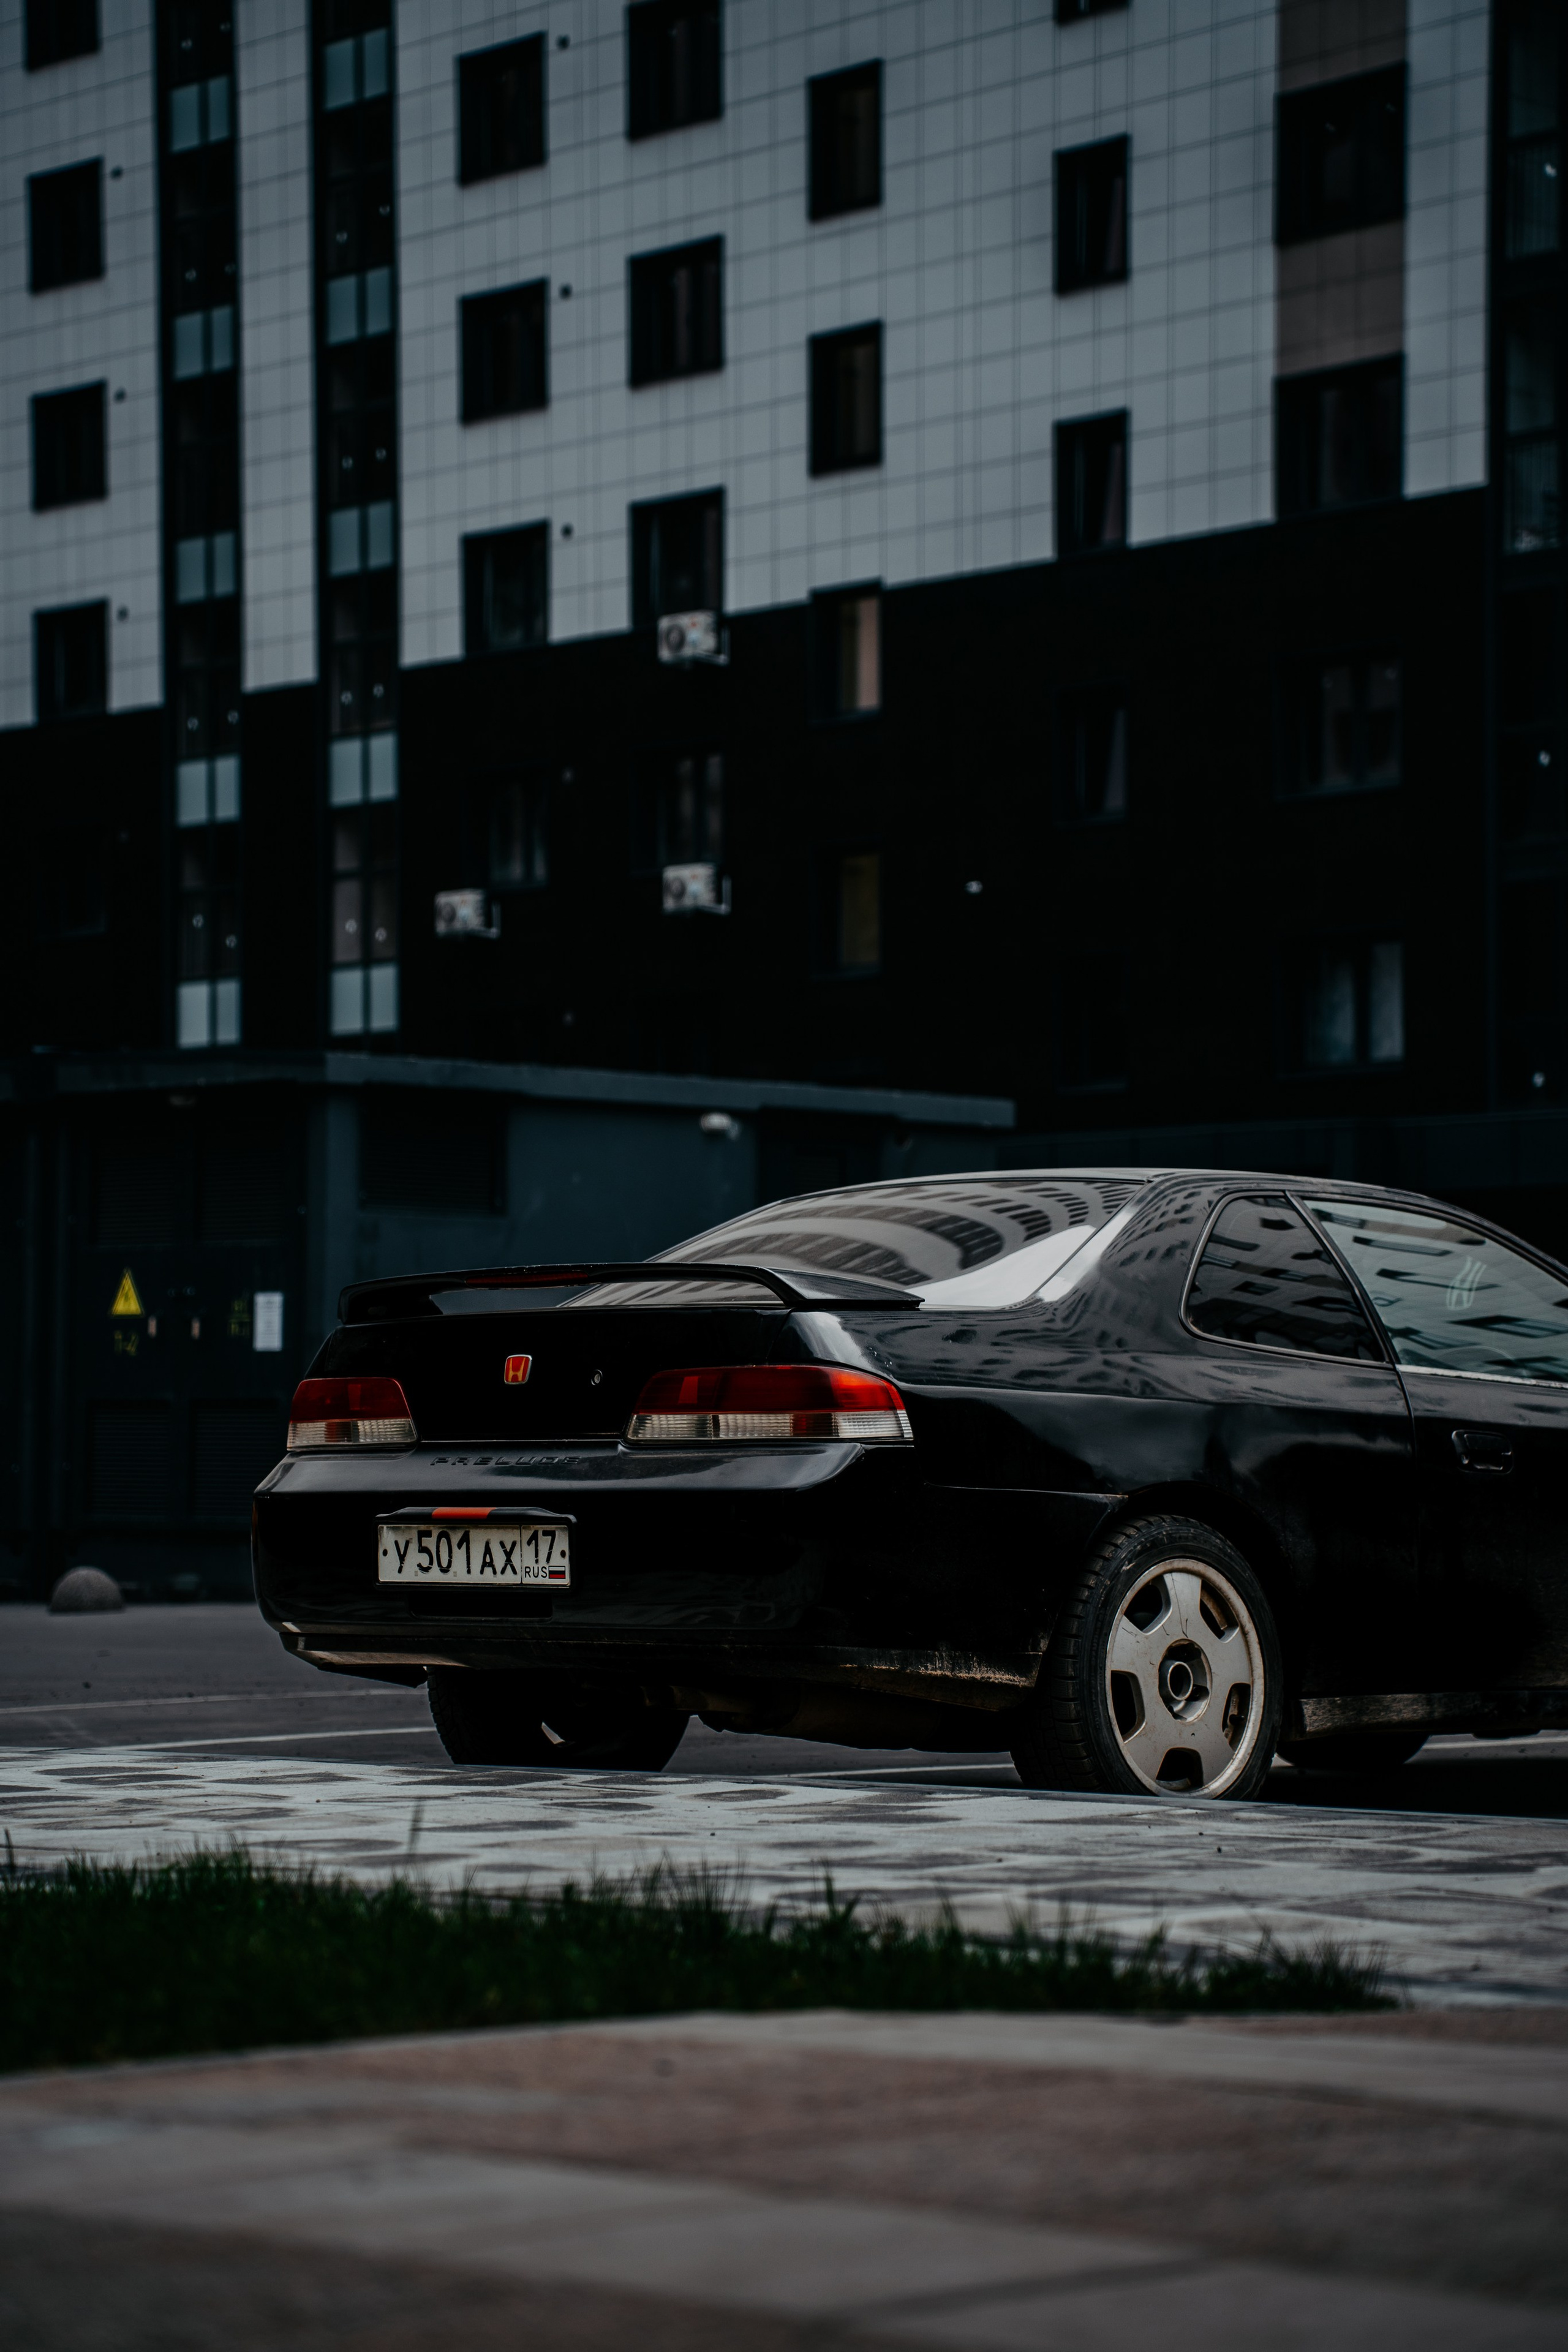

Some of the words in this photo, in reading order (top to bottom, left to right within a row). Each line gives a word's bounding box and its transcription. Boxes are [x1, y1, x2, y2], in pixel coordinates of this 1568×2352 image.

[429, 1456, 582, 1466] PRELUDE
[526, 1530, 556, 1564] 17
[524, 1566, 548, 1578] RUS
